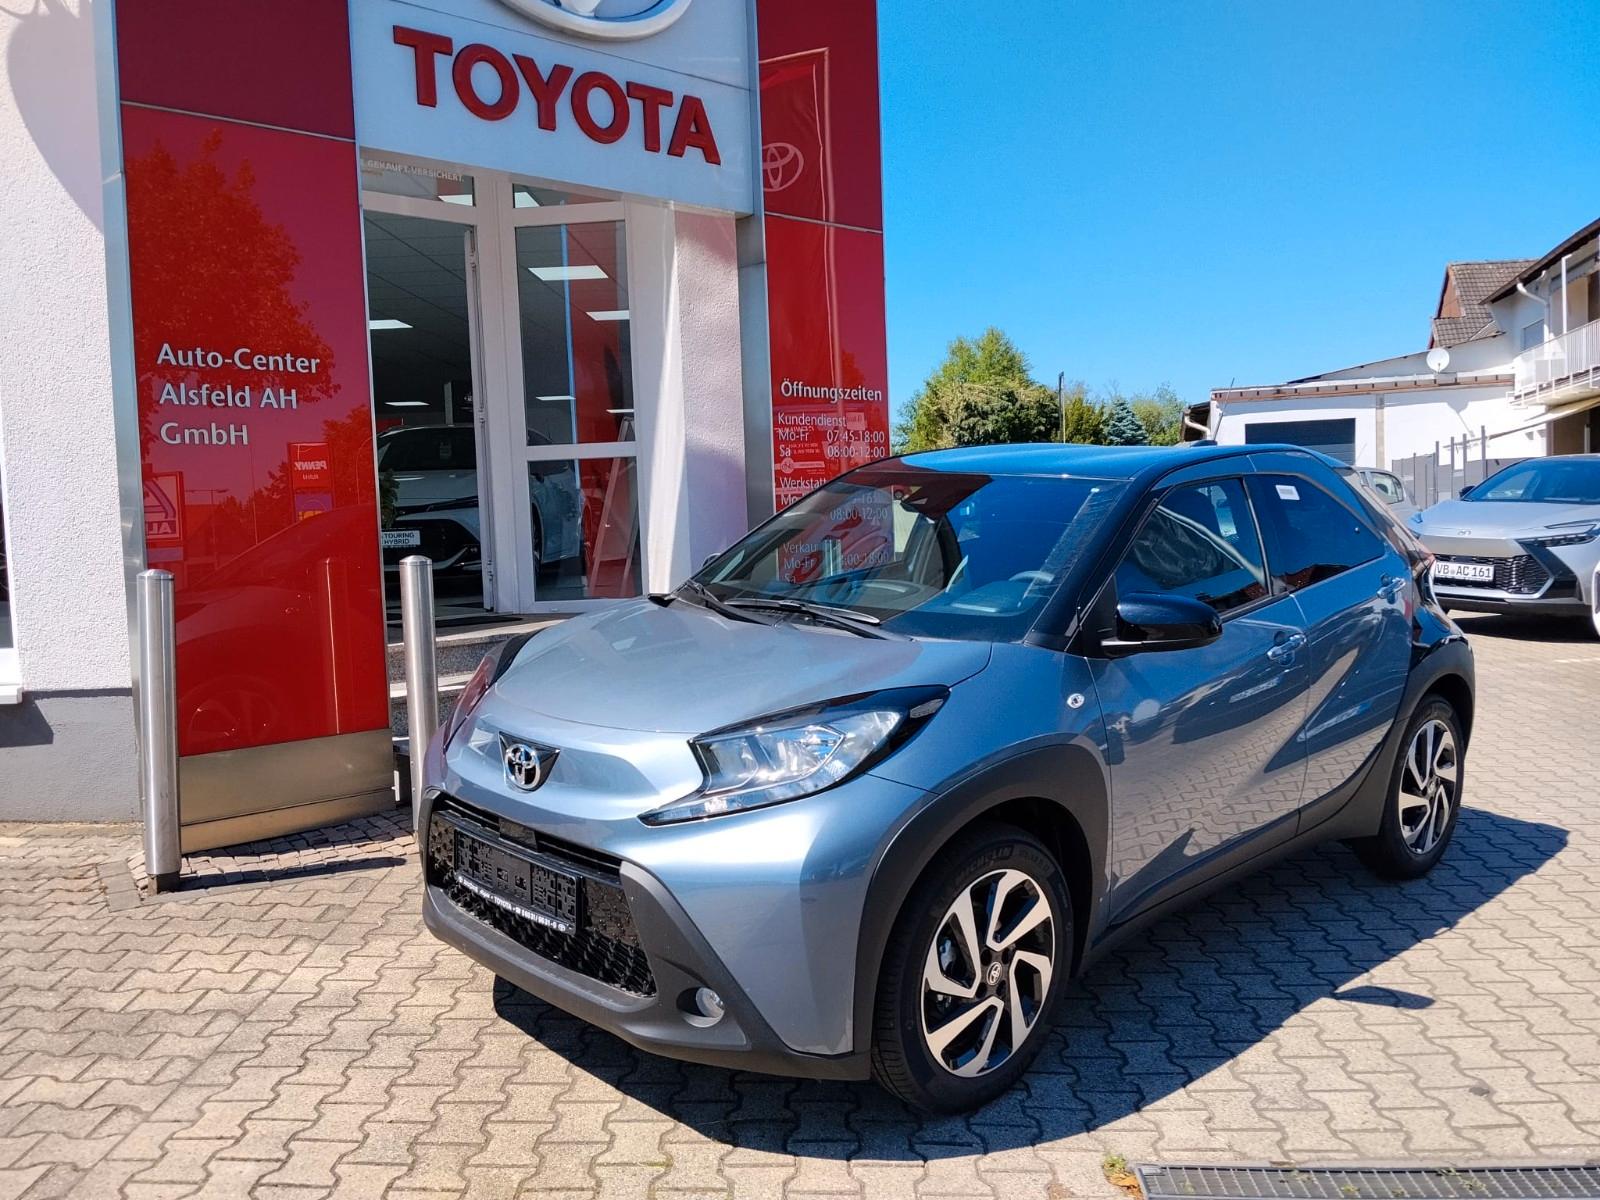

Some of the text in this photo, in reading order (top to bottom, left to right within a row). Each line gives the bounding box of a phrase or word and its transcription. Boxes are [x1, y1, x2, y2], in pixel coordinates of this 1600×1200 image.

[392, 25, 721, 166] TOYOTA
[157, 343, 320, 374] Auto-Center
[159, 384, 297, 410] Alsfeld AH
[780, 378, 882, 405] Öffnungszeiten
[778, 412, 847, 428] Kundendienst
[160, 423, 249, 446] GmbH
[778, 429, 809, 442] Mo-Fr
[827, 430, 885, 444] 07:45-18:00
[779, 445, 791, 457] Sa
[827, 446, 885, 458] 08:00-12:00
[780, 477, 827, 489] Werkstatt
[783, 543, 819, 554] Verkau
[1437, 564, 1491, 578] VB AC 161
